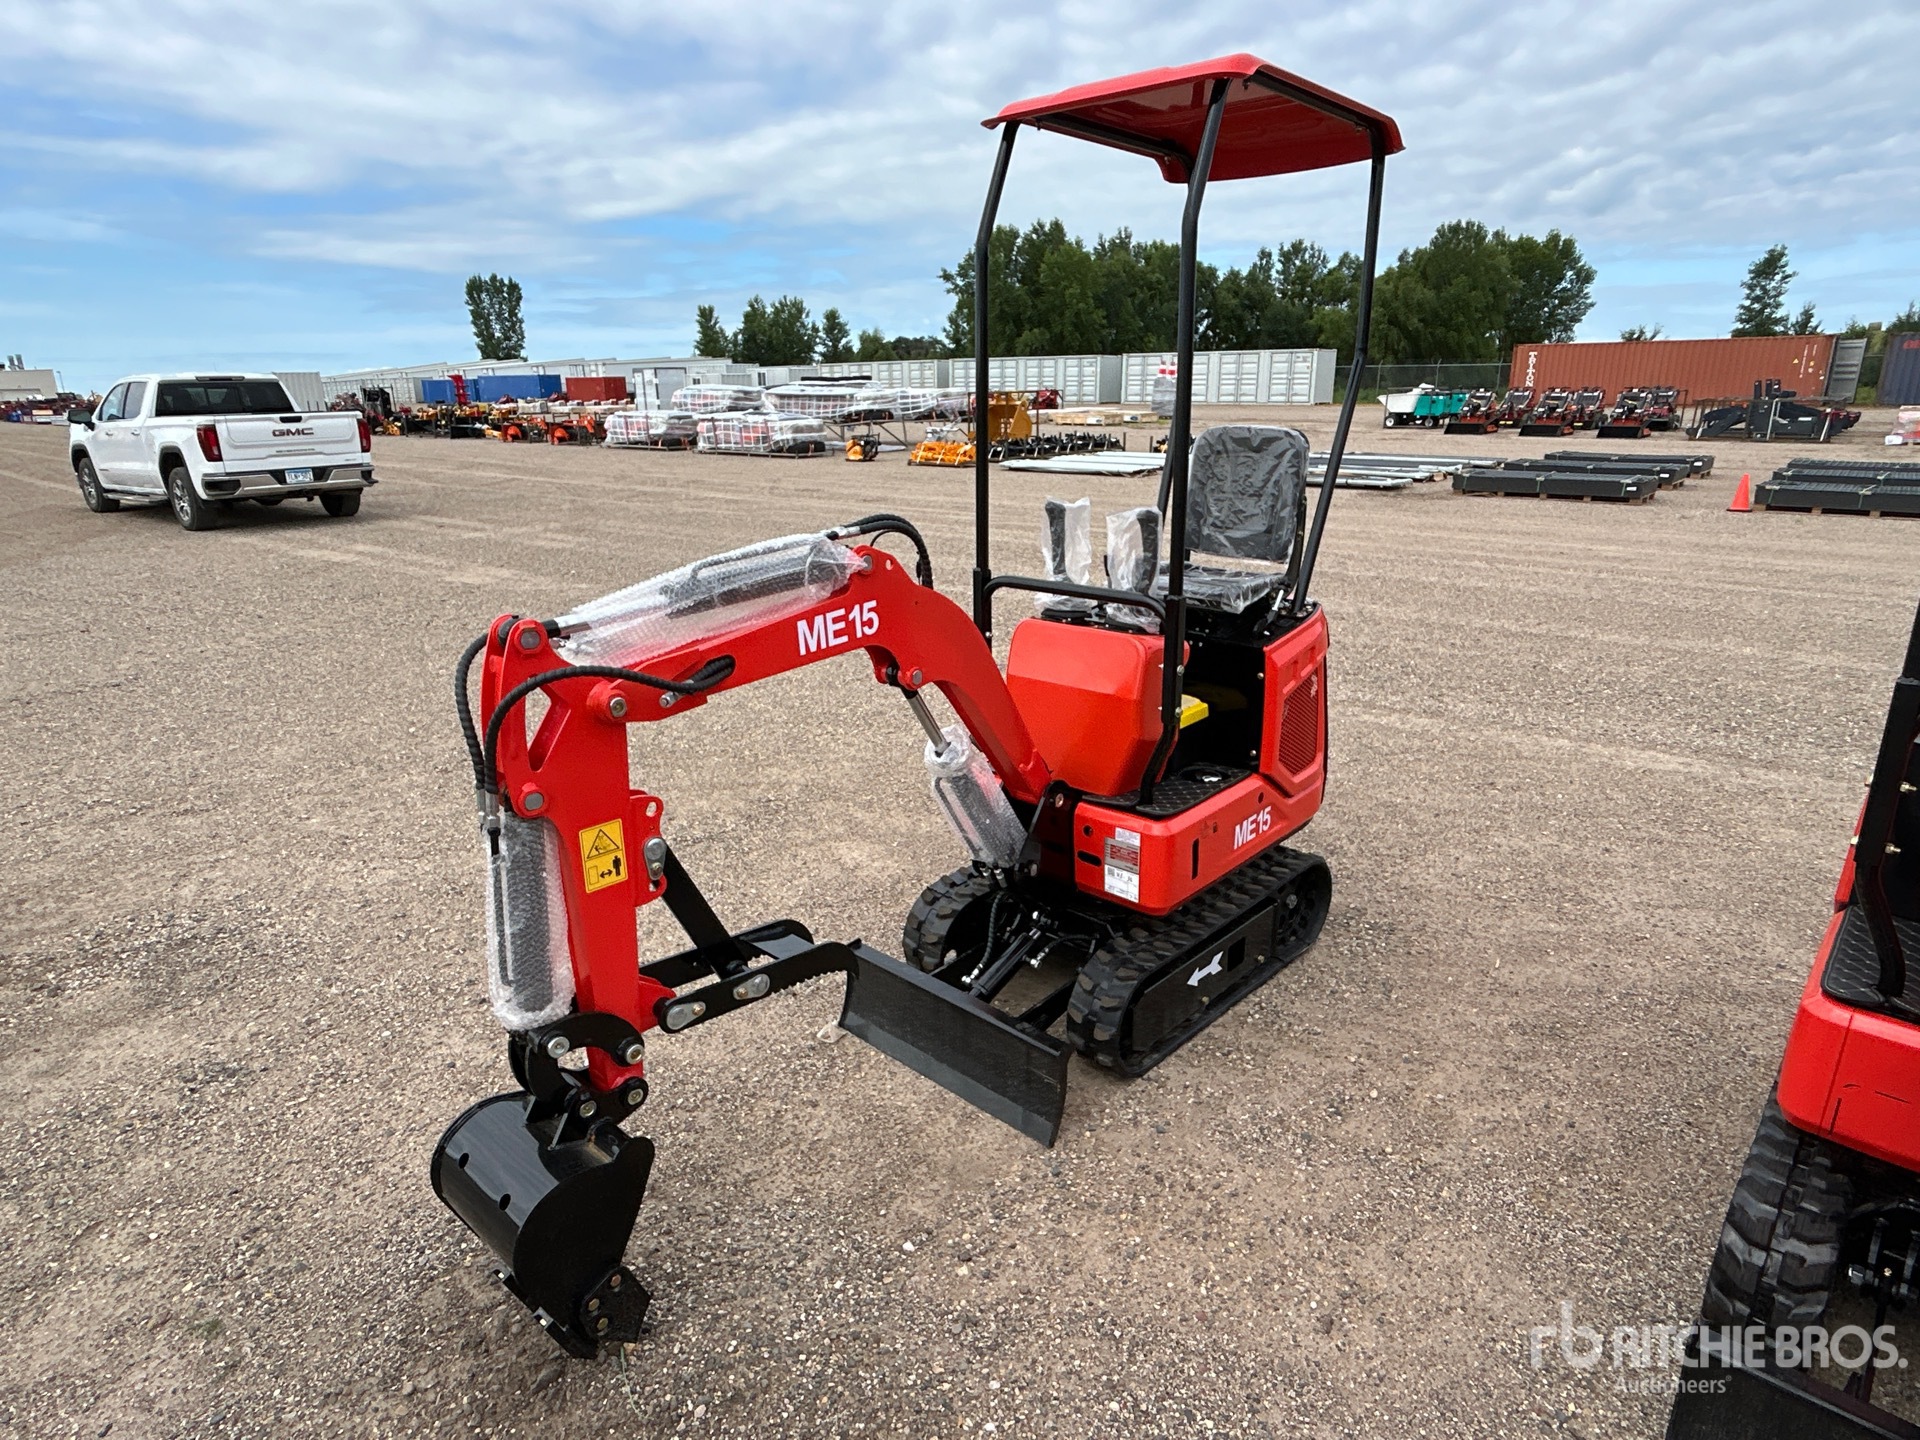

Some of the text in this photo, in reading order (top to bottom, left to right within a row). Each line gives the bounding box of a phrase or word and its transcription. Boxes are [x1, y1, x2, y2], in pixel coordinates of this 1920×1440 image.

[1525, 351, 1538, 387] TRITON
[272, 427, 314, 437] GMC
[796, 599, 879, 656] ME15
[1233, 805, 1271, 850] ME15
